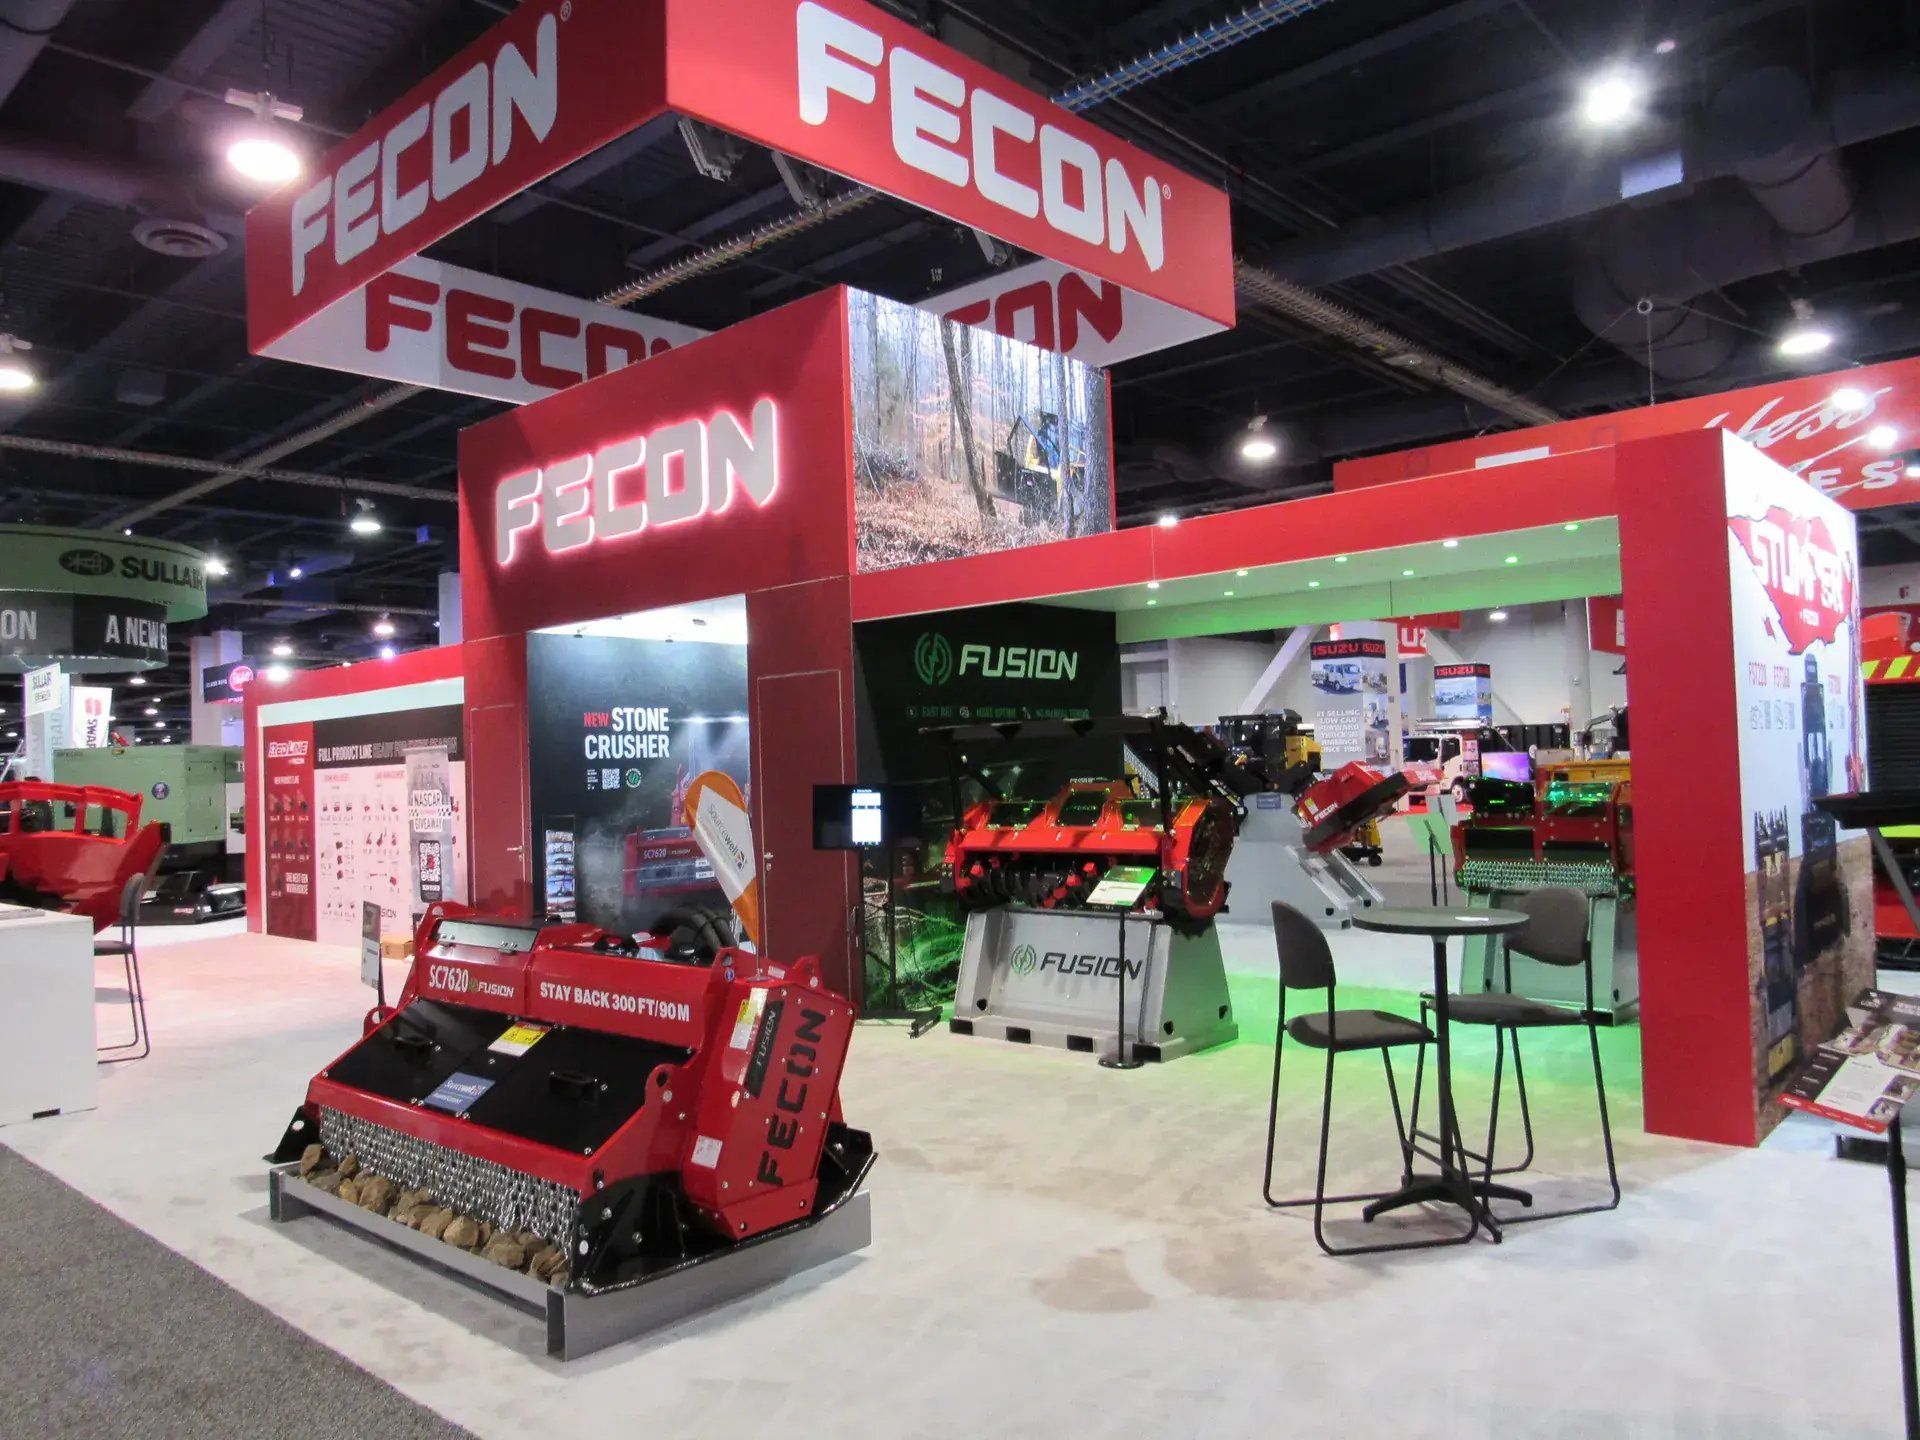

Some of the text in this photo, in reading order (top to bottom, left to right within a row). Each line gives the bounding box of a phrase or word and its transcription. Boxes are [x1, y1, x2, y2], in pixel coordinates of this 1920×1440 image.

[797, 2, 1165, 272] FECON
[292, 13, 557, 296] FECON
[365, 271, 672, 390] FECO
[496, 398, 778, 566] FECON
[126, 616, 160, 648] NEW
[959, 644, 1078, 681] FUSION
[1313, 642, 1360, 656] ISUZU
[1437, 666, 1474, 676] ISUZU
[584, 707, 670, 732] NEW STONE
[318, 747, 332, 762] FULL
[333, 745, 359, 761] PRODUCT
[584, 734, 670, 760] CRUSHER
[414, 791, 441, 806] NASCAR
[1314, 802, 1338, 821] FECON
[428, 964, 514, 998] SC7620 FUSION
[1040, 952, 1143, 980] FUSION
[540, 982, 571, 1001] STAY
[574, 987, 610, 1009] BACK
[612, 994, 635, 1013] 300
[755, 1010, 777, 1067] FUSION
[757, 1008, 827, 1187] FECON
